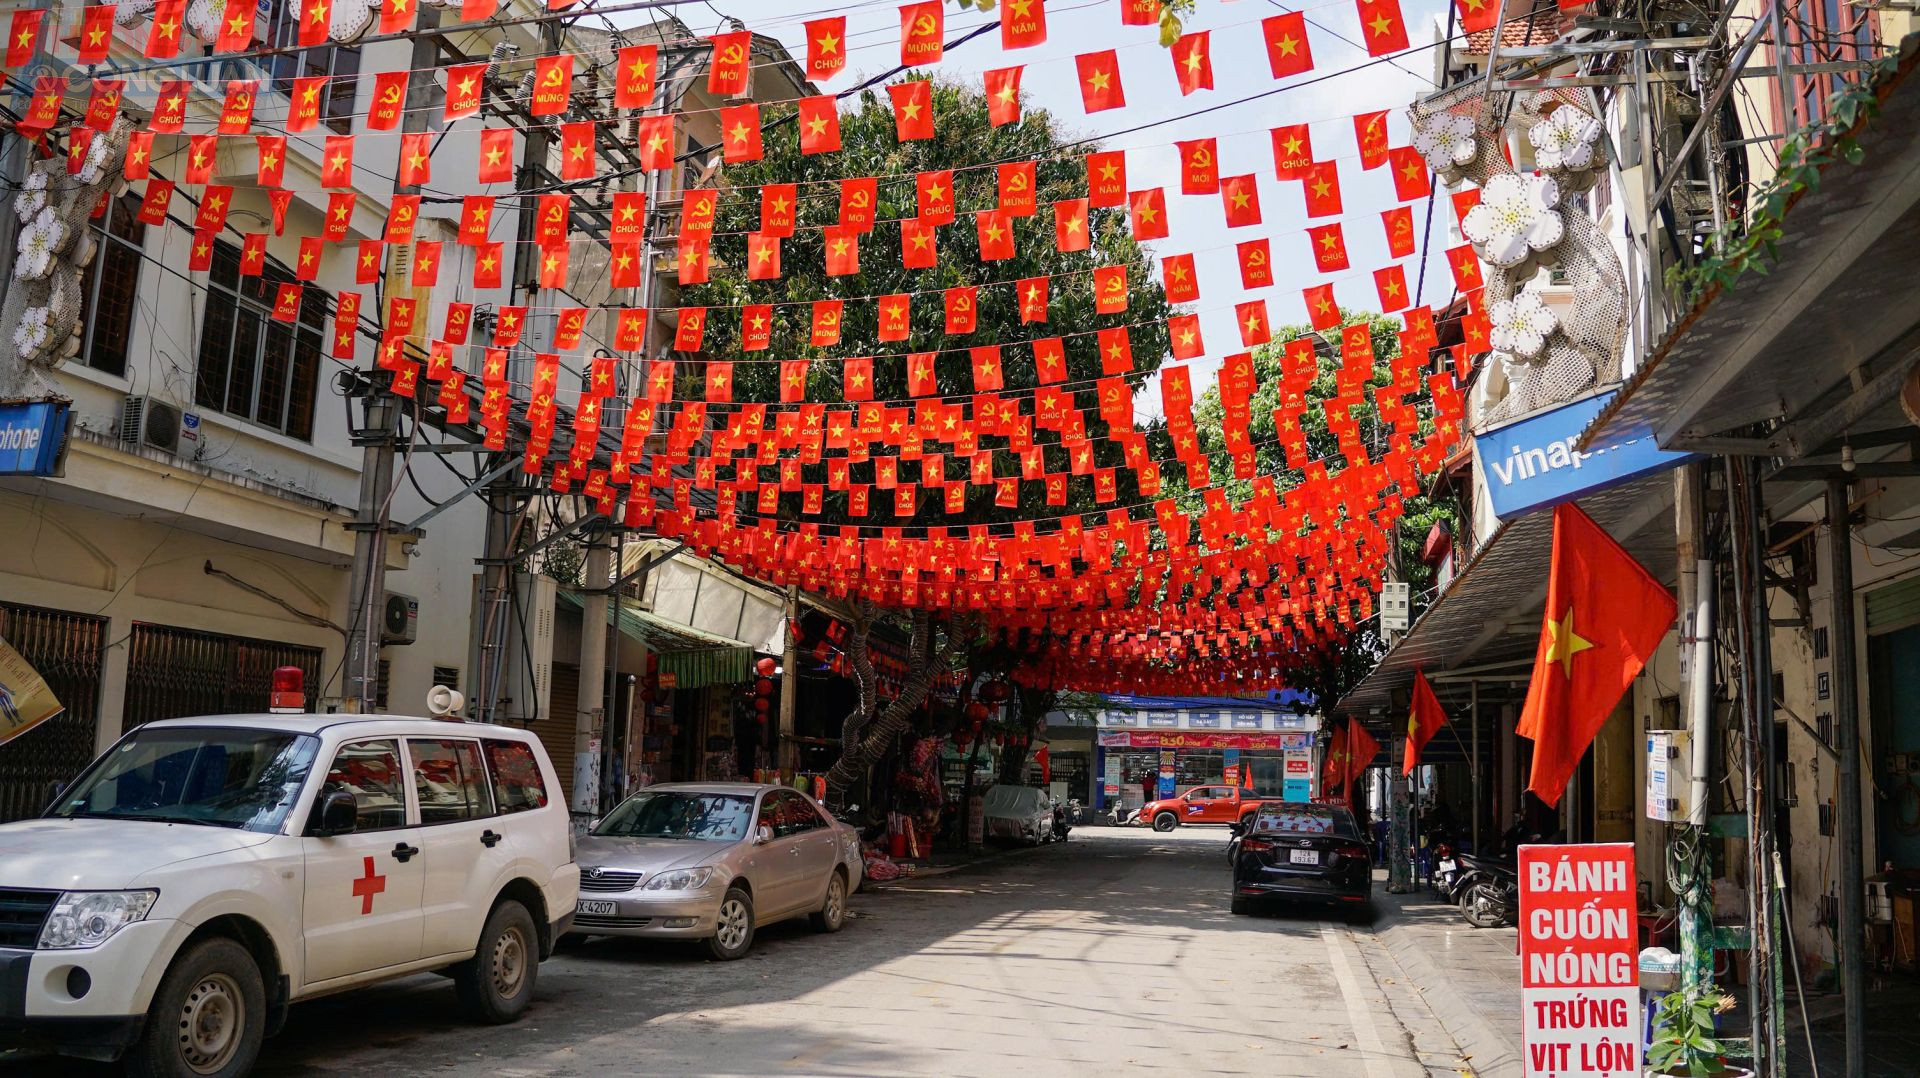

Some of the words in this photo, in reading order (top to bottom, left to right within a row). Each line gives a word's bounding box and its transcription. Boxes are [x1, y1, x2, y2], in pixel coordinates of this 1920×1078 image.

[1011, 22, 1036, 34] NĂM
[907, 41, 939, 54] MỪNG
[815, 56, 843, 70] CHÚC
[719, 70, 739, 81] MỚI
[627, 83, 649, 94] NĂM
[536, 92, 564, 103] MỪNG
[452, 98, 478, 111] CHÚC
[378, 108, 395, 119] MỚI
[158, 115, 181, 124] CHÚC
[225, 114, 248, 124] MỪNG
[1282, 157, 1310, 170] CHÚC
[1192, 174, 1210, 183] MỚI
[1099, 184, 1121, 194] NĂM
[1003, 196, 1031, 207] MỪNG
[202, 212, 219, 224] NĂM
[769, 218, 789, 227] NĂM
[390, 226, 411, 235] MỪNG
[468, 225, 486, 233] NĂM
[616, 222, 639, 233] CHÚC
[688, 221, 712, 230] MỪNG
[544, 226, 561, 236] MỚI
[1321, 251, 1344, 263] CHÚC
[1250, 270, 1266, 280] MỚI
[1173, 284, 1192, 294] NĂM
[1102, 294, 1126, 305] MỪNG
[278, 306, 296, 315] CHÚC
[953, 315, 968, 324] MỚI
[886, 322, 904, 331] NĂM
[499, 330, 518, 338] CHÚC
[748, 332, 768, 340] CHÚC
[815, 328, 838, 337] MỪNG
[624, 334, 640, 343] NĂM
[1296, 364, 1316, 375] CHÚC
[1285, 400, 1303, 409] CHÚC
[580, 414, 596, 424] CHÚC
[1040, 410, 1060, 420] CHÚC
[980, 419, 994, 427] MỚI
[802, 426, 820, 435] CHÚC
[862, 426, 882, 434] MỪNG
[1066, 431, 1083, 440] CHÚC
[1529, 855, 1626, 892] BÁNH
[1530, 897, 1629, 940] CUỐN
[1530, 946, 1631, 984] NÓNG
[1533, 993, 1627, 1029] TRỨNG
[1530, 1043, 1571, 1078] VỊT
[1581, 1037, 1634, 1078] LỘN
